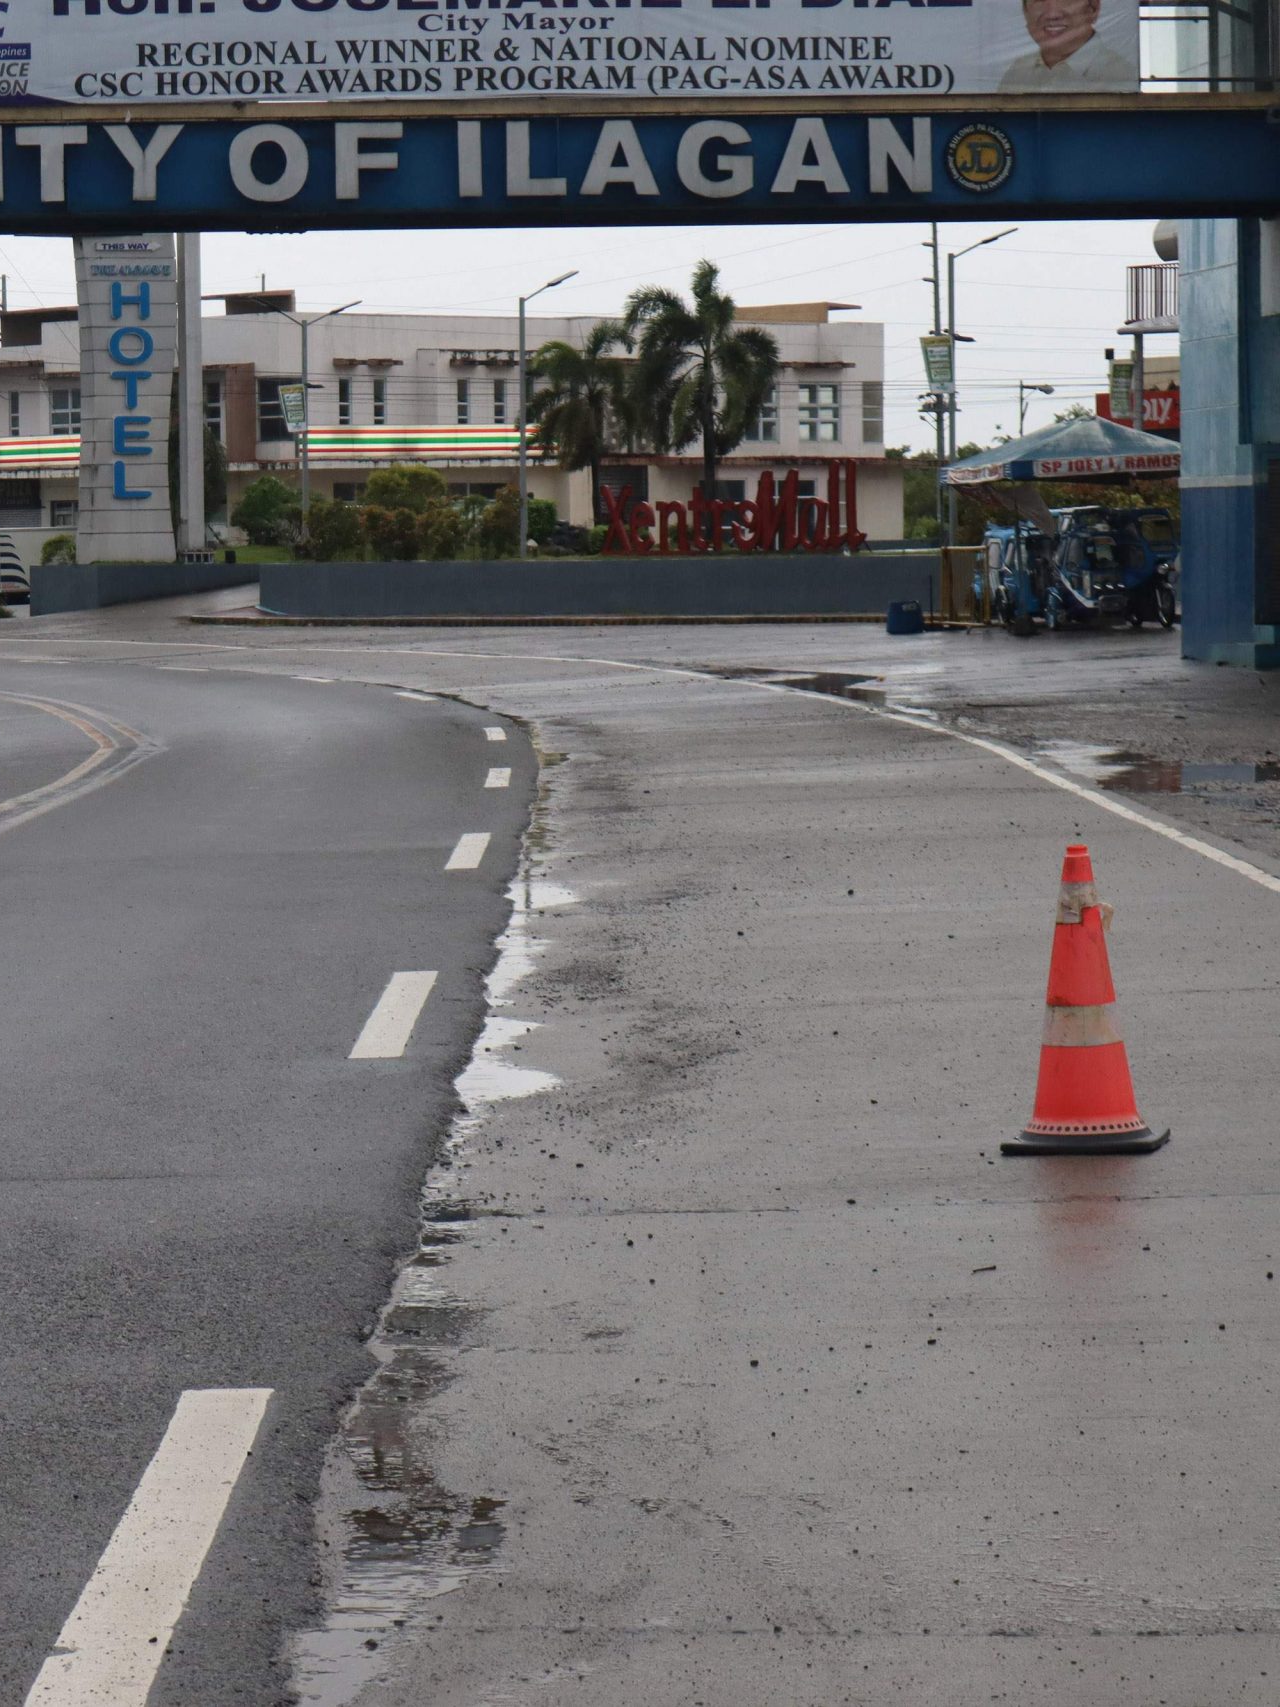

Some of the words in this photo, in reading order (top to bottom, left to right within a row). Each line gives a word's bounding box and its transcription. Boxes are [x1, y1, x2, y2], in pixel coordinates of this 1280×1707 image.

[418, 14, 489, 35] City
[503, 13, 615, 35] Mayor
[136, 41, 327, 67] REGIONAL
[335, 38, 483, 63] WINNER
[493, 37, 520, 62] &
[531, 37, 716, 62] NATIONAL
[725, 36, 894, 61] NOMINEE
[74, 72, 143, 97] CSC
[155, 70, 287, 96] HONOR
[295, 68, 442, 93] AWARDS
[453, 66, 637, 91] PROGRAM
[647, 65, 811, 95] (PAG-ASA
[818, 64, 955, 94] AWARD)
[228, 121, 404, 202] OF
[456, 116, 932, 198] ILAGAN
[101, 243, 125, 251] THIS
[127, 242, 149, 250] WAY
[108, 281, 154, 499] HOTEL
[1041, 461, 1061, 474] SP
[1067, 458, 1103, 472] JOEY
[1125, 453, 1181, 469] RAMOS
